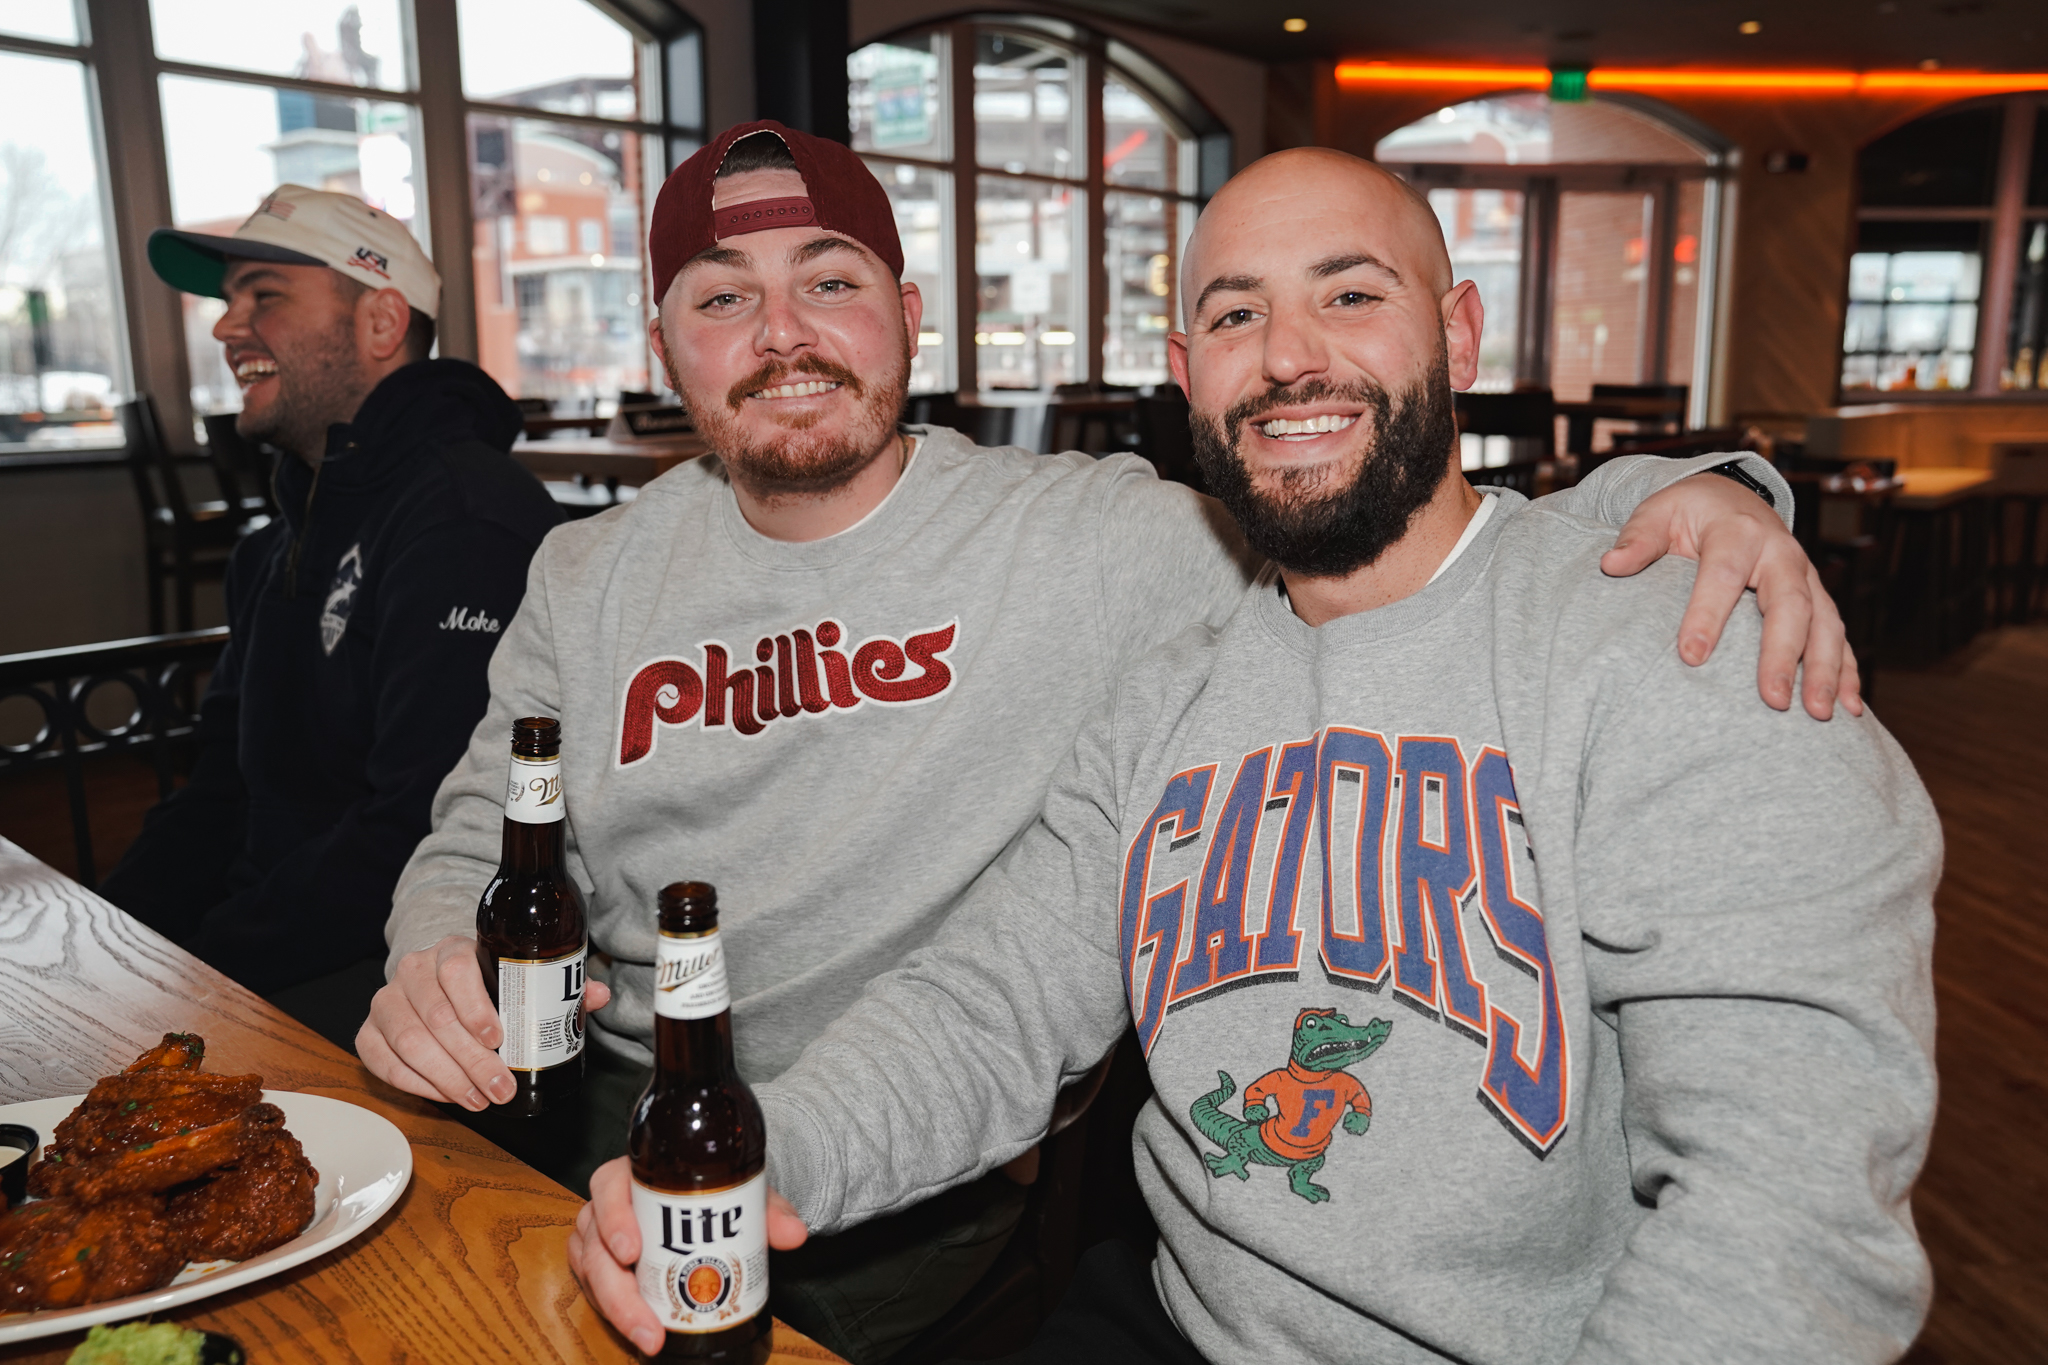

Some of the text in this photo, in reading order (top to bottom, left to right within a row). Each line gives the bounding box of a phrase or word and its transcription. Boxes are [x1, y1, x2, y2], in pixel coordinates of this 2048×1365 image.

[356, 247, 387, 271] USA
[1120, 726, 1572, 1156] GATORS
[656, 947, 720, 984] Miller
[1290, 1089, 1337, 1137] F
[659, 1203, 743, 1256] Lite
